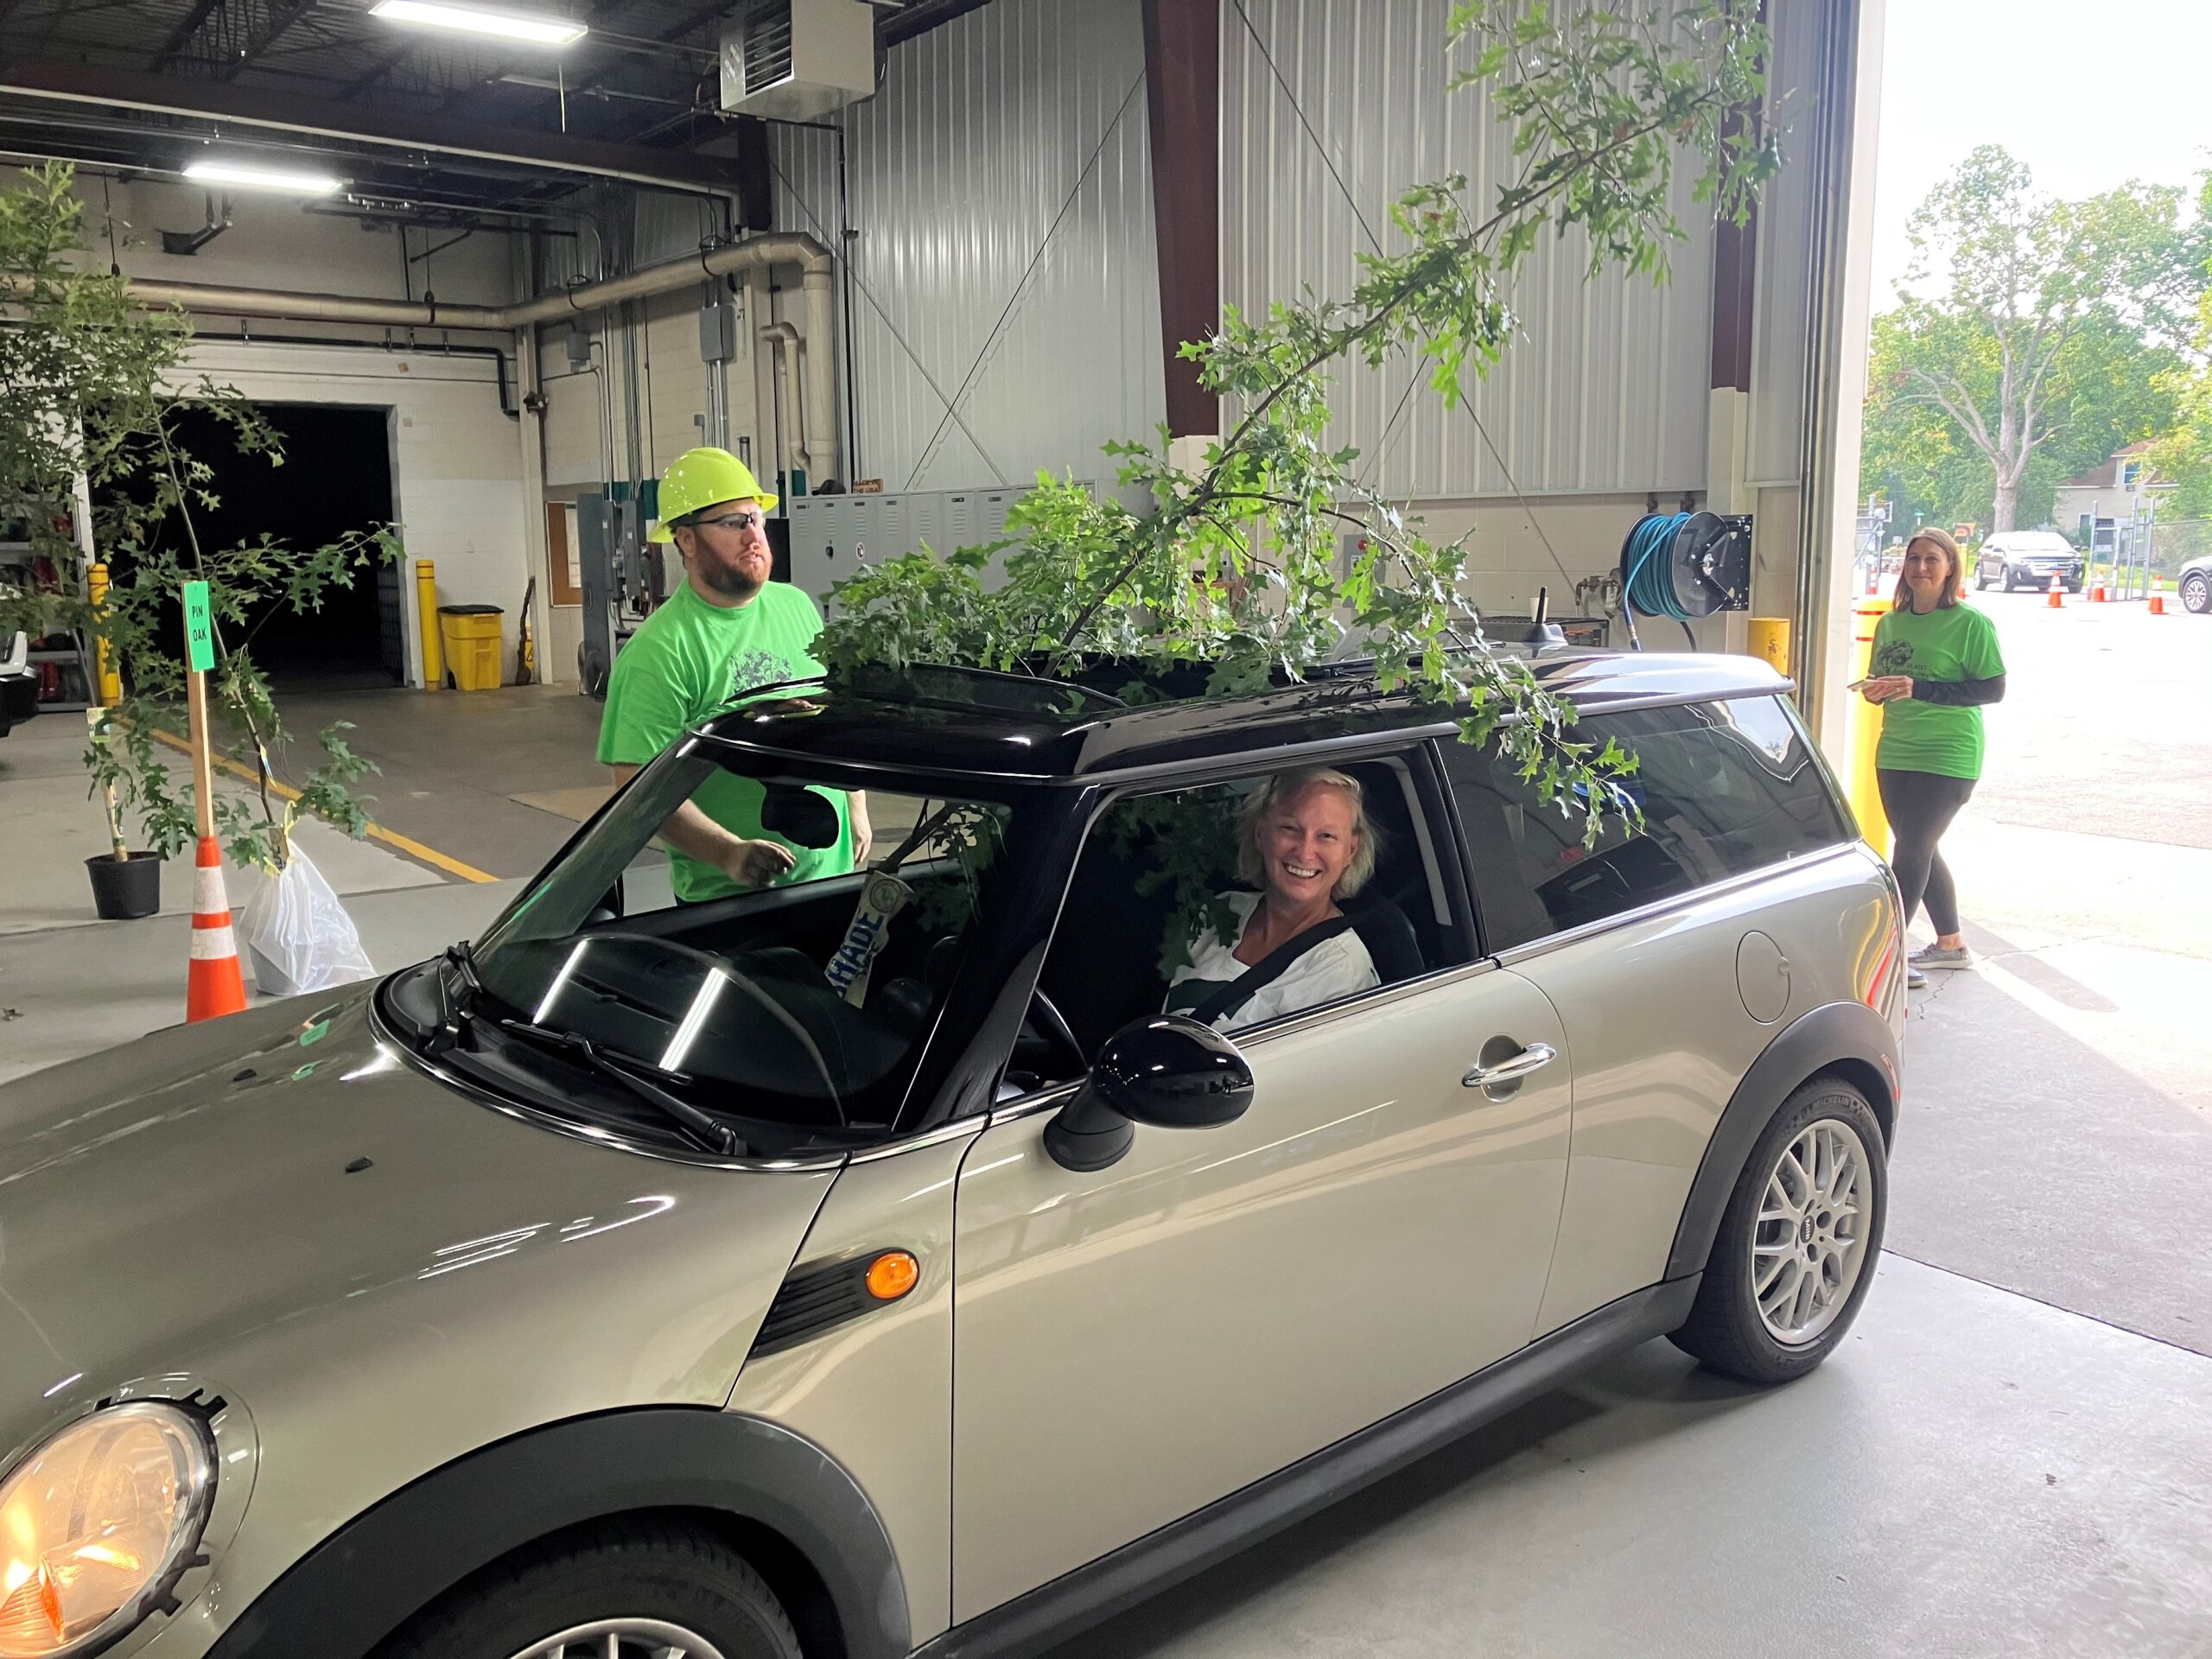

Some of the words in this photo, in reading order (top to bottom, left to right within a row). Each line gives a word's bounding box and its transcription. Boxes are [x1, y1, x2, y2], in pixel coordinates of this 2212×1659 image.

[192, 605, 203, 619] PIN
[193, 628, 207, 642] OAK
[1812, 1095, 1850, 1109] MICHELIN
